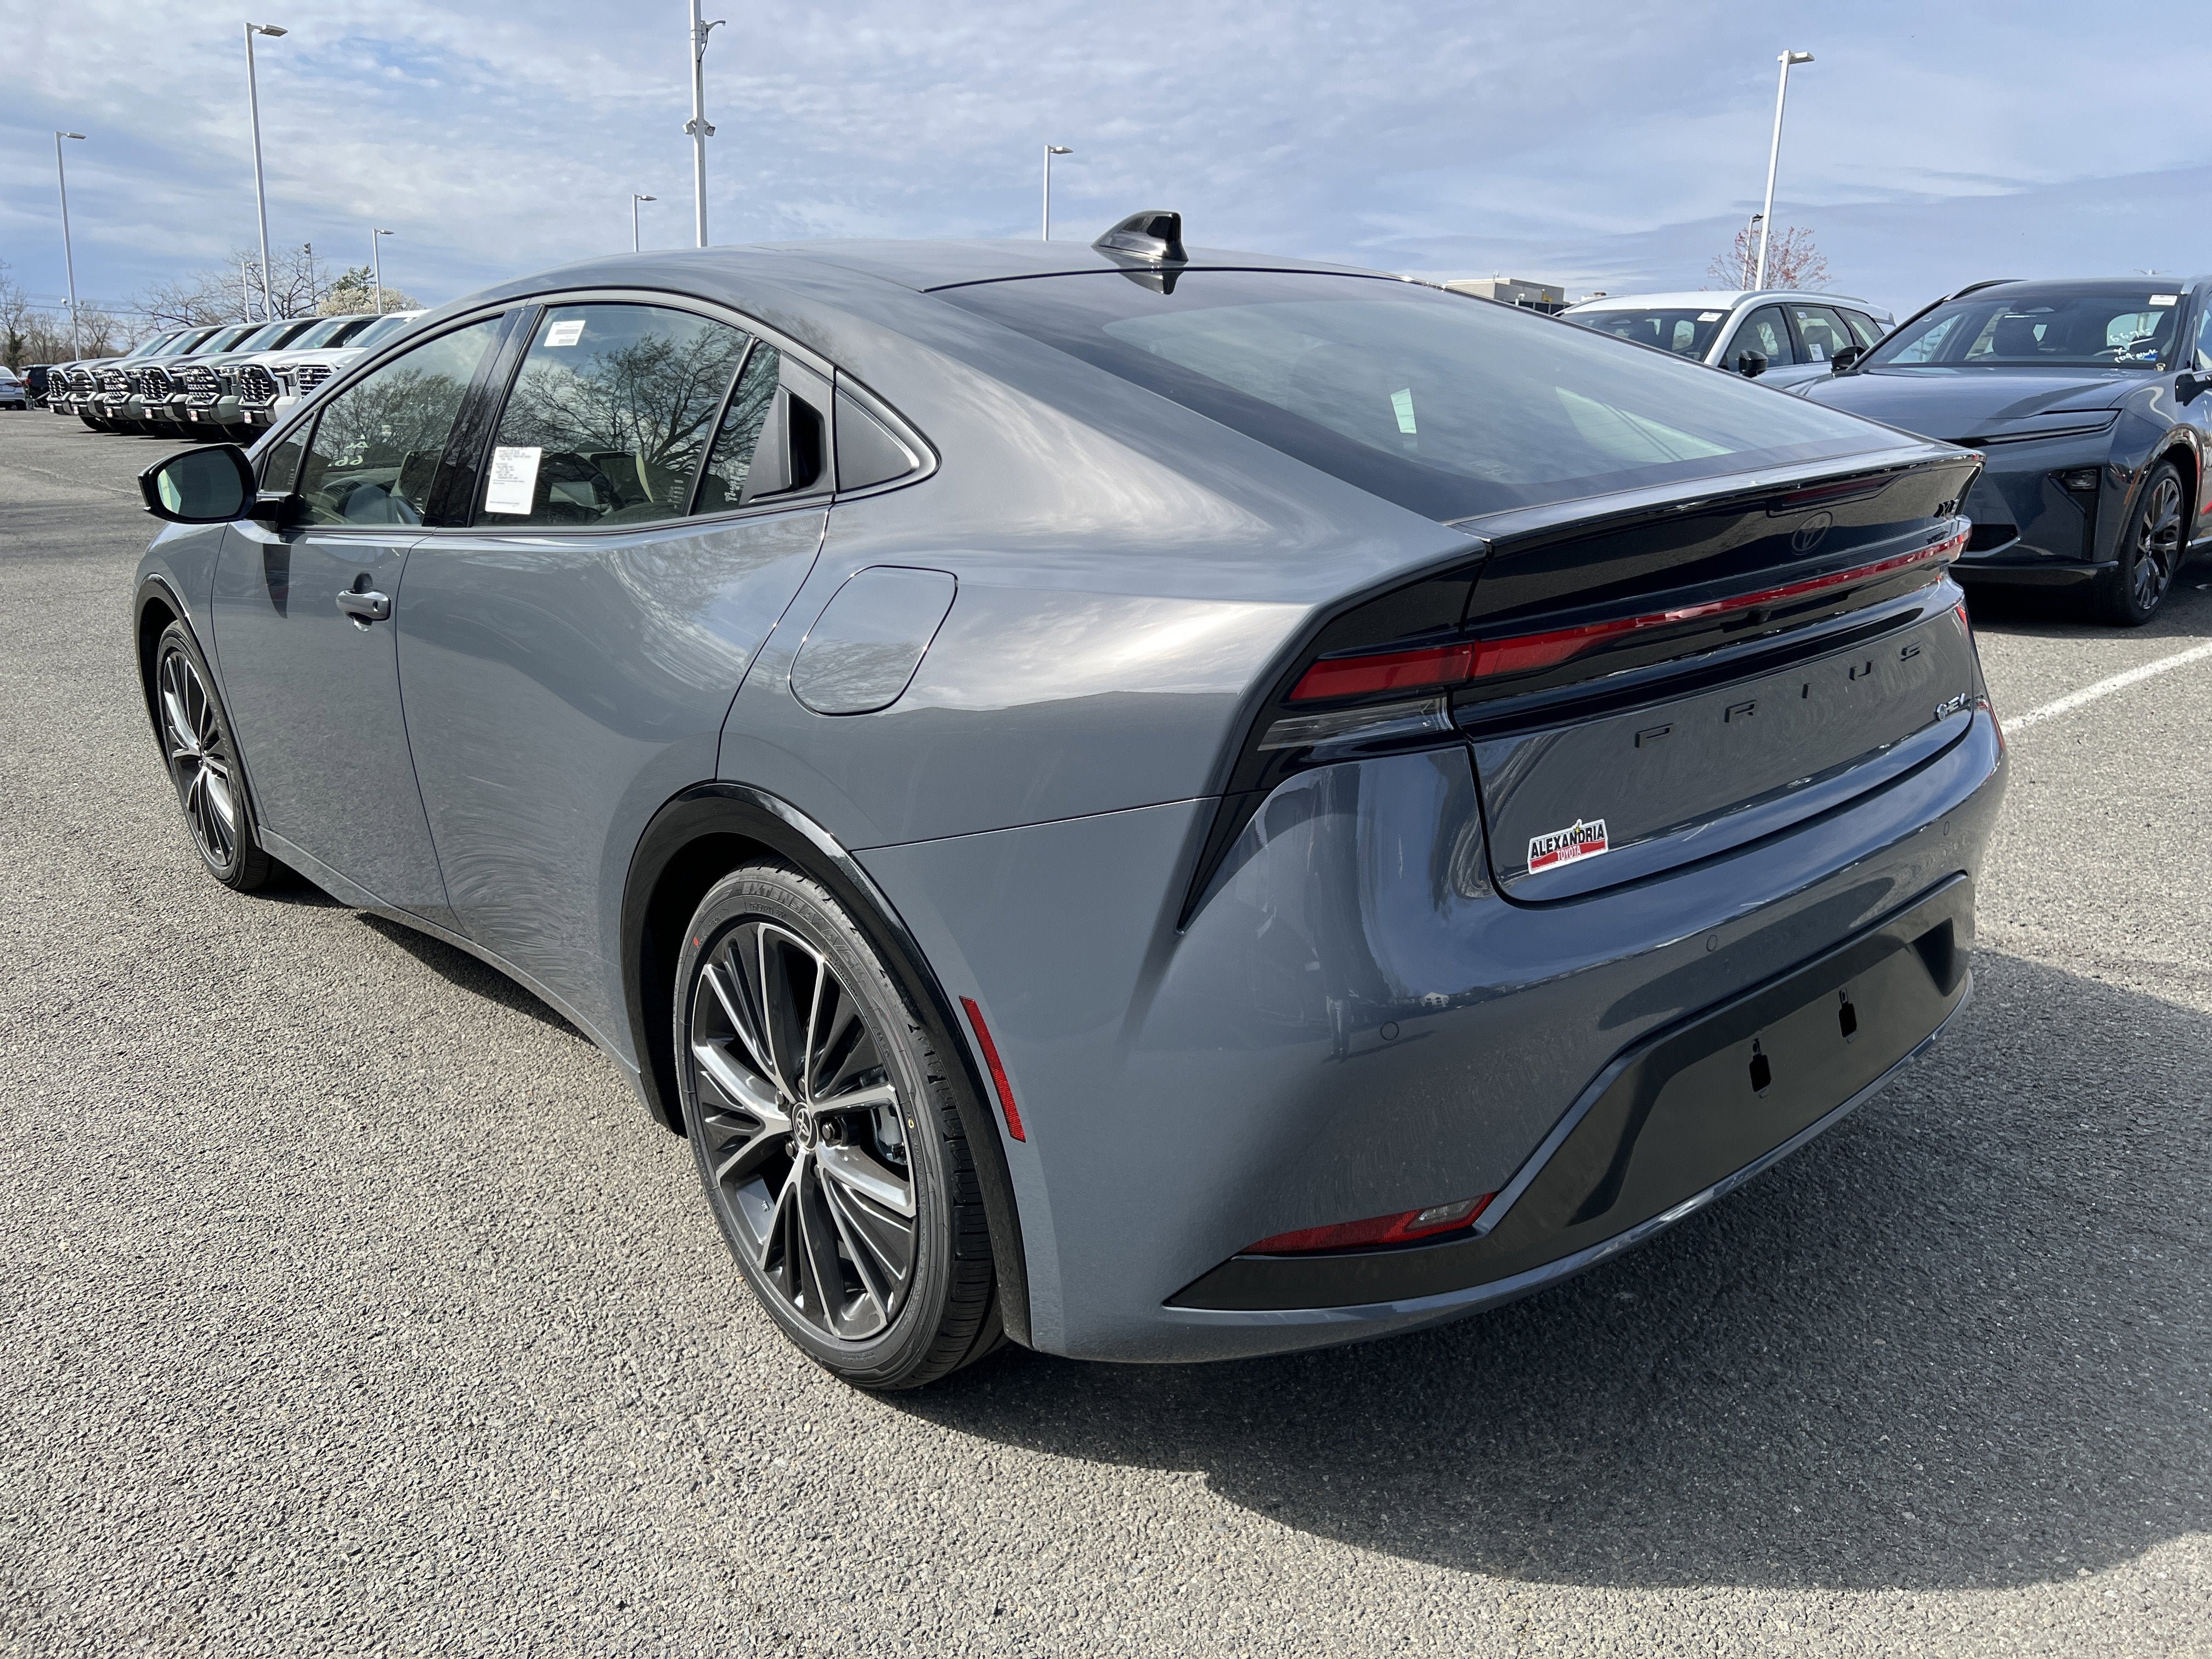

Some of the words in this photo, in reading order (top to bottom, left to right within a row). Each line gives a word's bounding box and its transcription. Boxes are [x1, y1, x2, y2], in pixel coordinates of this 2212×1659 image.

[1634, 641, 1923, 748] PRIUS
[1944, 692, 1965, 714] HEV
[1531, 824, 1604, 859] ALEXANDRIA
[1556, 845, 1581, 861] TOYOTA
[742, 882, 816, 924] EXTENSA
